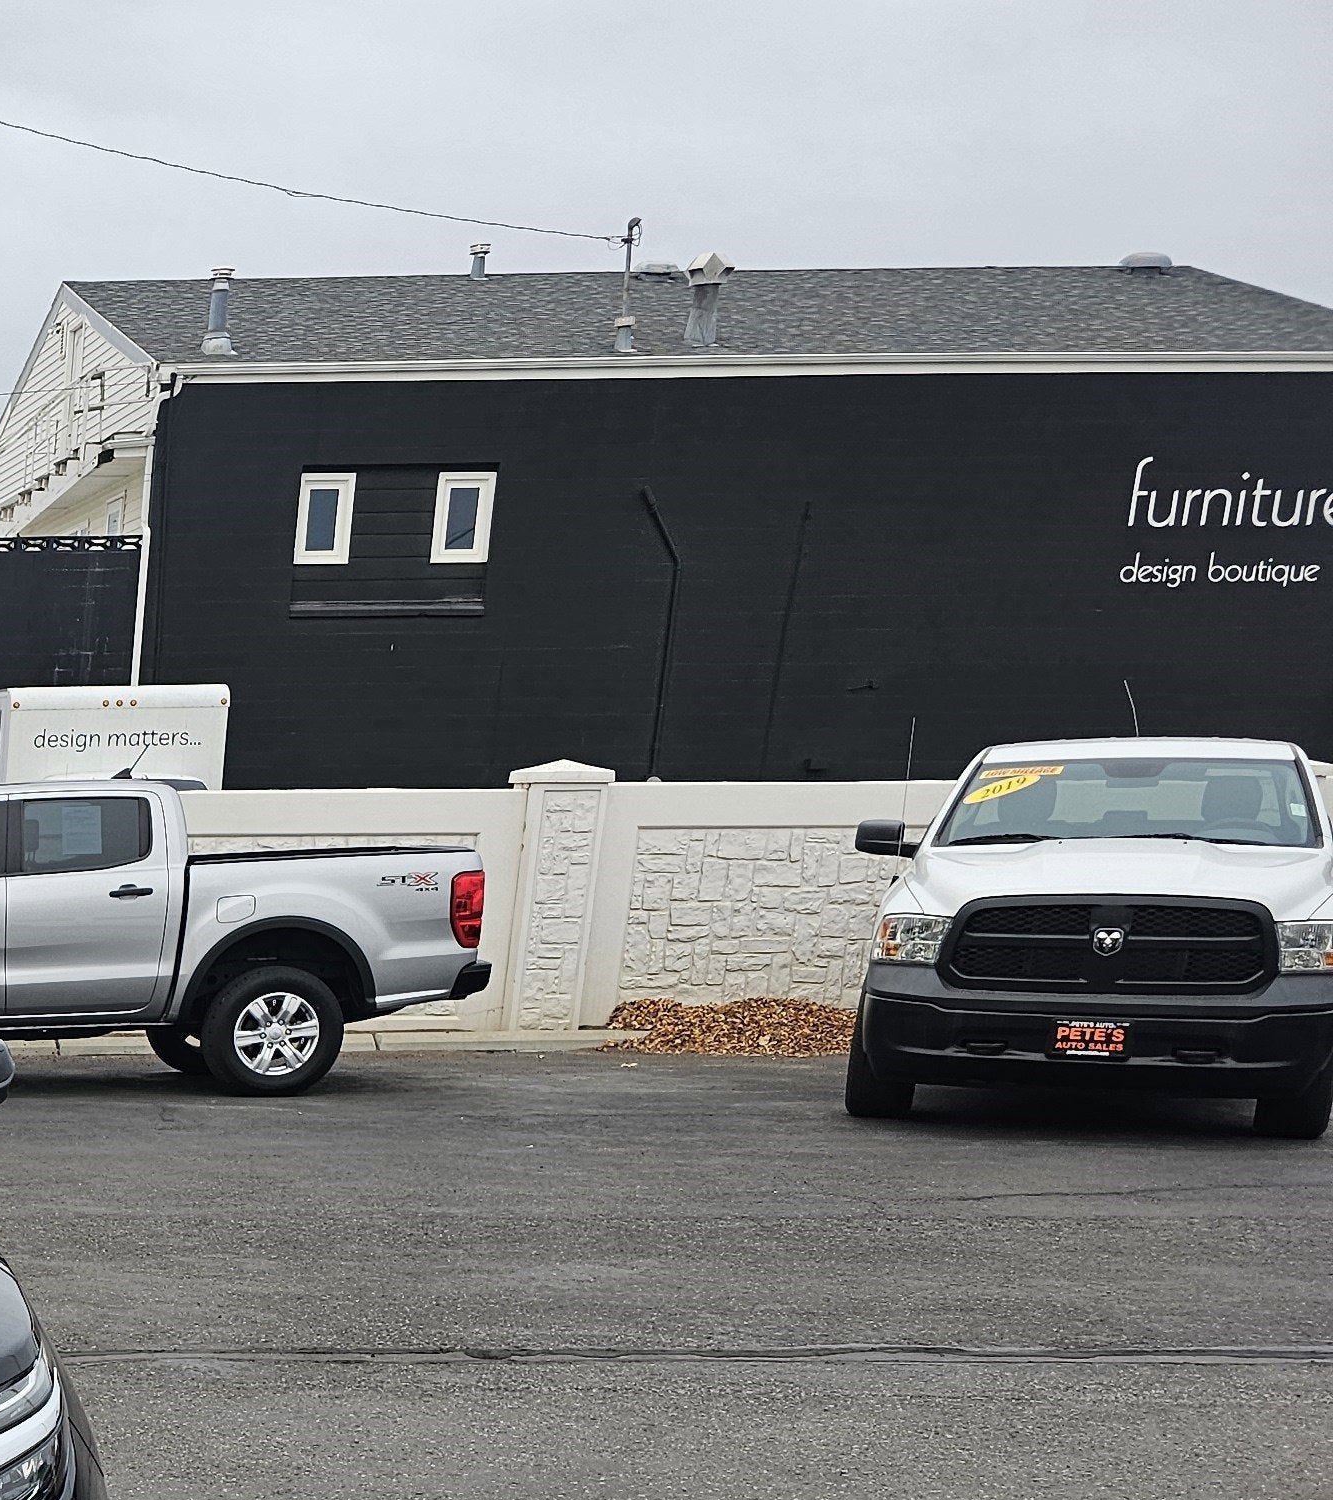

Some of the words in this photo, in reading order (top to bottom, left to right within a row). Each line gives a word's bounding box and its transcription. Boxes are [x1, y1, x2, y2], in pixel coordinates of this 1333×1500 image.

[1119, 551, 1197, 588] design
[1207, 551, 1322, 588] boutique
[33, 728, 101, 753] design
[107, 729, 203, 748] matters...
[981, 776, 1027, 799] 2019
[377, 871, 439, 887] STX
[1056, 1026, 1125, 1042] PETE'S
[1054, 1041, 1086, 1050] AUTO
[1088, 1042, 1124, 1051] SALES
